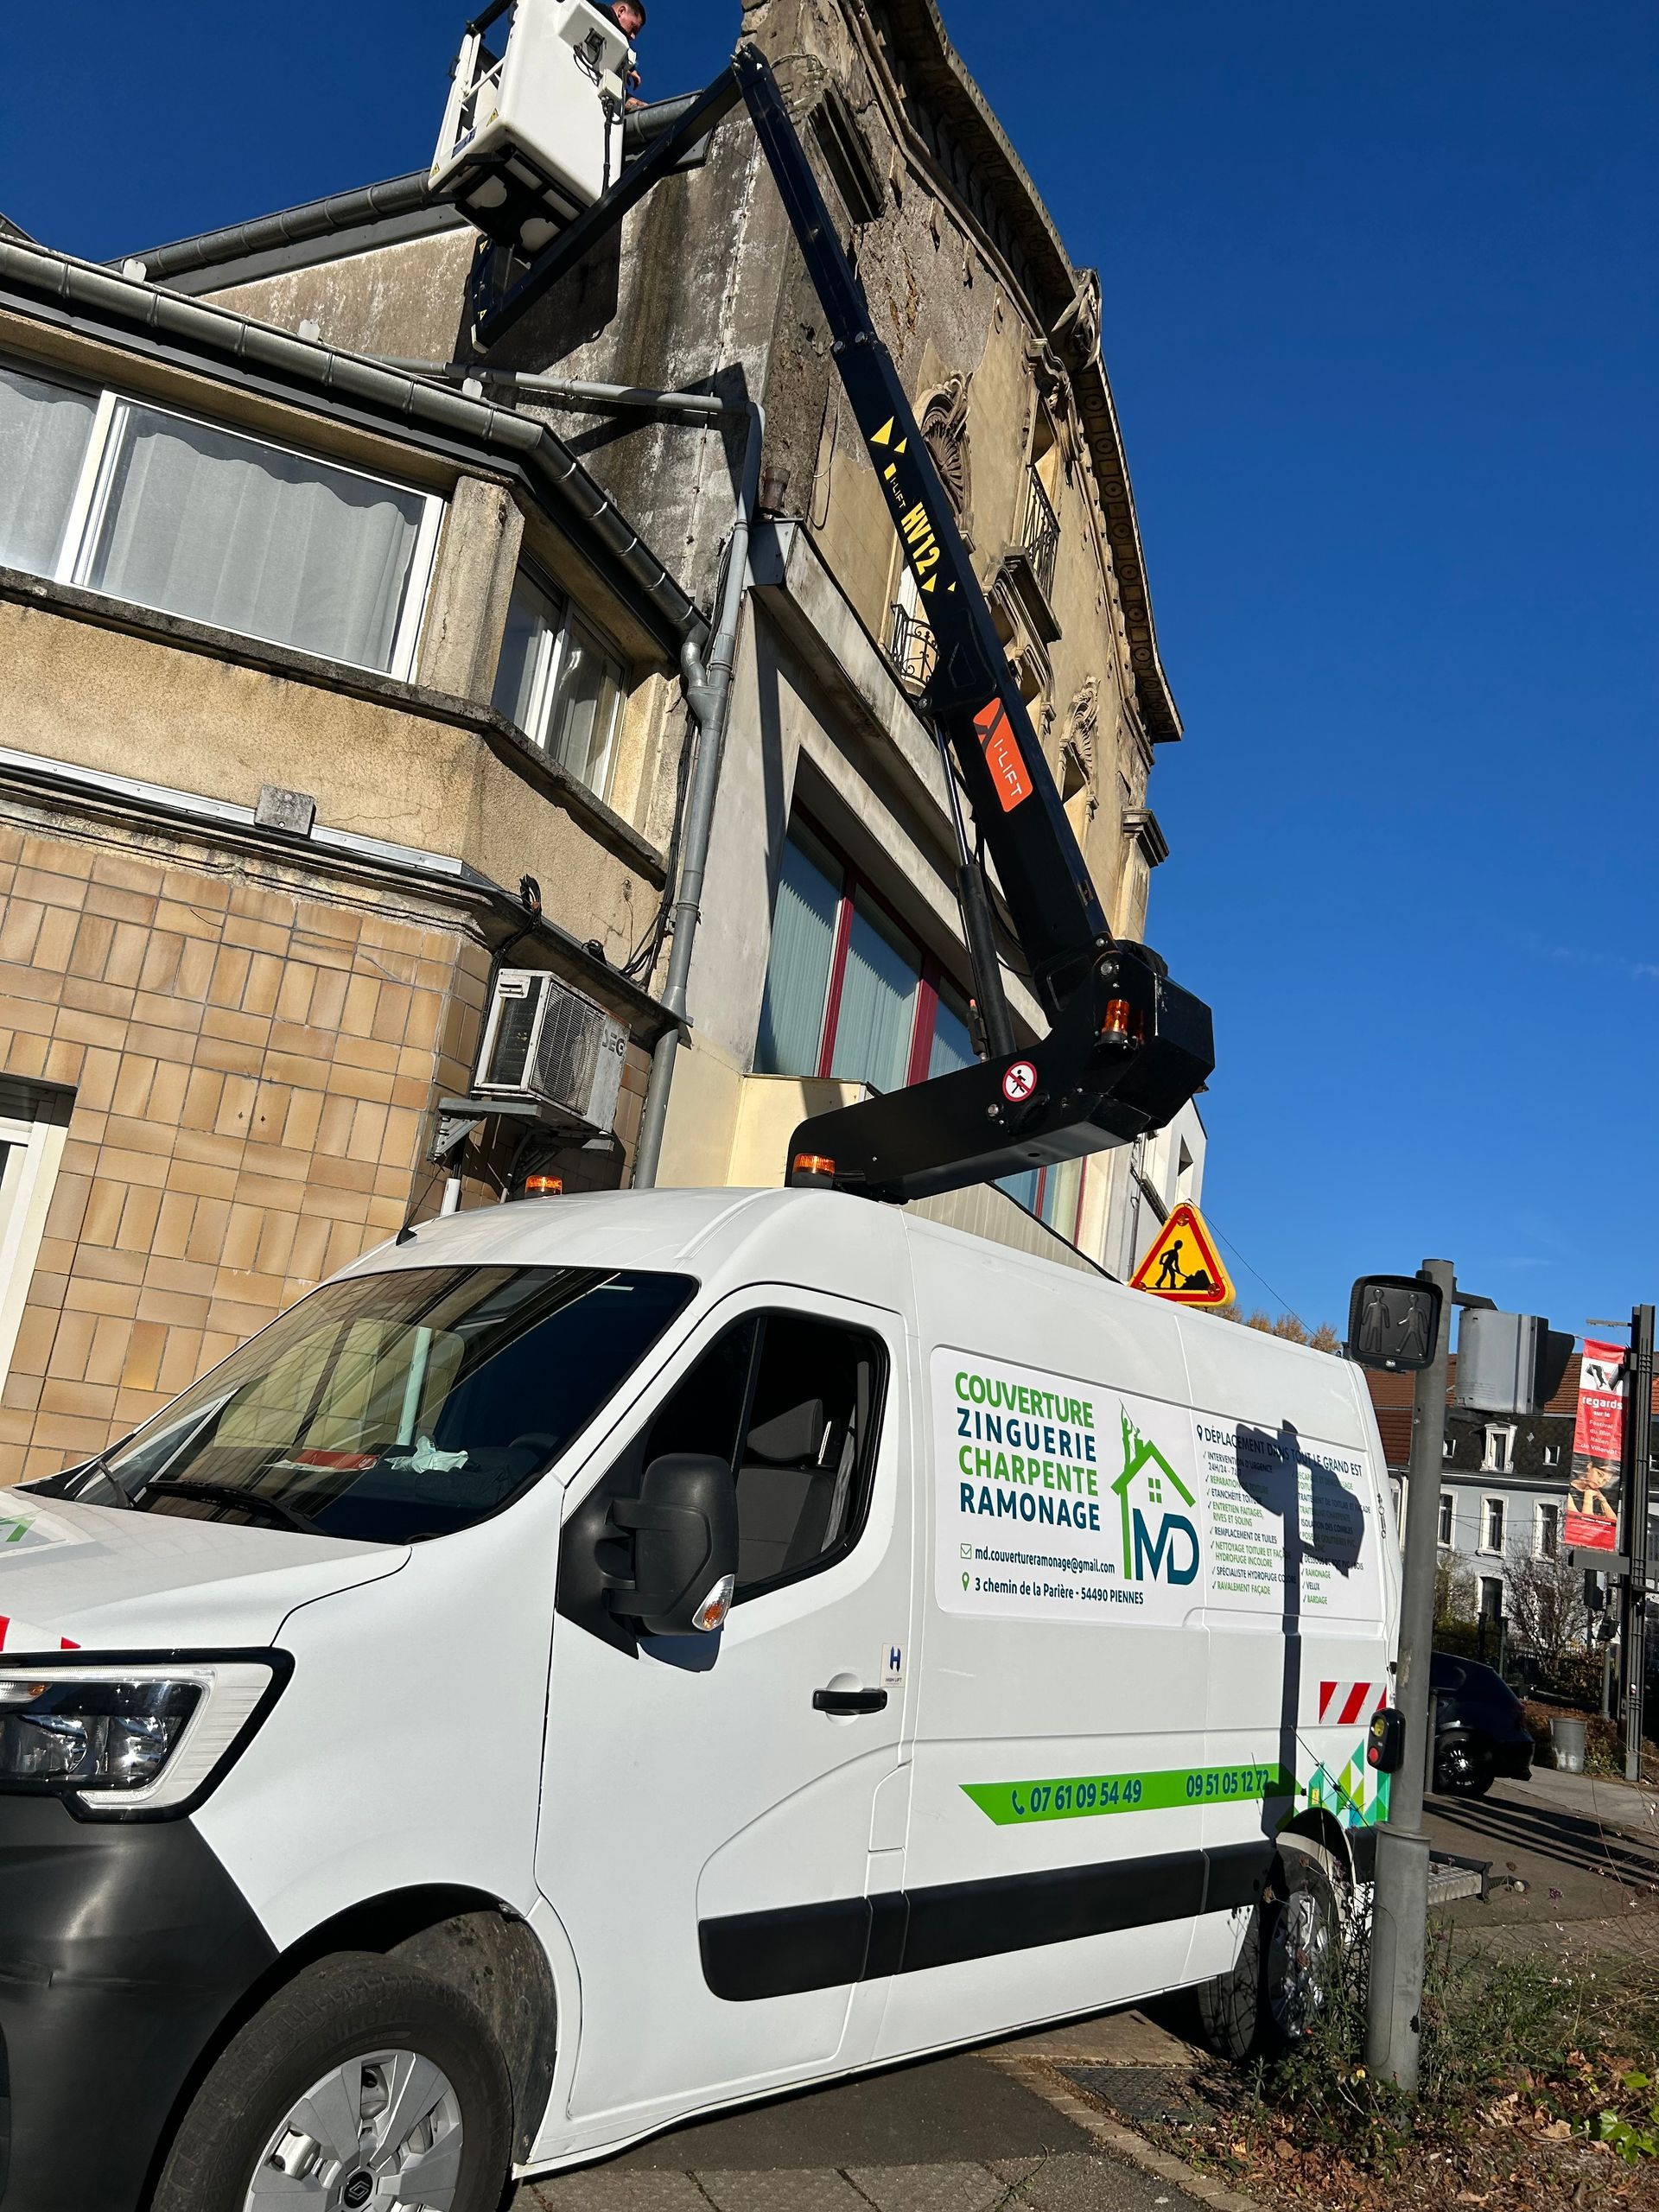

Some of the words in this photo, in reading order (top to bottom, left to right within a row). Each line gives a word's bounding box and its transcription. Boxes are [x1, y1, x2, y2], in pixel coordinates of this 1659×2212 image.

[900, 501, 940, 575] HV12
[955, 1371, 1095, 1428] COUVERTURE
[1582, 1396, 1623, 1410] regards
[1589, 1419, 1613, 1429] Festival
[957, 1407, 1096, 1462] ZINGUERIE
[1205, 1425, 1264, 1454] DÉPLACEMENT
[1267, 1442, 1290, 1460] DANS
[1291, 1449, 1312, 1466] TOUT
[1313, 1453, 1323, 1467] LE
[1323, 1457, 1350, 1473] GRAND
[1350, 1462, 1363, 1477] EST
[958, 1445, 1098, 1497] CHARPENTE
[960, 1482, 1101, 1531] RAMONAGE
[1212, 1501, 1239, 1514] ENTRETIEN
[1212, 1512, 1227, 1522] RIVES
[1227, 1515, 1234, 1523] ET
[1234, 1516, 1253, 1527] SOLINS
[1214, 1526, 1253, 1539] REMPLACEMENT
[1254, 1532, 1262, 1541] DE
[1262, 1534, 1278, 1544] TUILES
[1133, 1507, 1200, 1586] MD
[1215, 1541, 1245, 1554] NETTOYAGE
[1245, 1545, 1266, 1556] TOITURE
[1267, 1548, 1273, 1557] ET
[975, 1546, 1115, 1574] md.couvertureramonage@gmail.com
[1215, 1552, 1247, 1564] HYDROFUGE
[1248, 1556, 1273, 1567] INCOLORE
[1248, 1570, 1278, 1581] HYDROFUGE
[1306, 1568, 1331, 1579] RAMONAGE
[975, 1577, 981, 1591] 3
[983, 1578, 1018, 1595] chemin
[1020, 1580, 1031, 1595] de
[1033, 1582, 1041, 1596] la
[1043, 1584, 1074, 1599] Parière
[1081, 1588, 1109, 1601] 54490
[1109, 1589, 1144, 1605] PIENNES
[1217, 1581, 1250, 1592] RAVALEMENT
[1306, 1581, 1320, 1591] VELUX
[1307, 1595, 1328, 1605] BARDAGE
[1186, 1774, 1203, 1798] 09
[1205, 1773, 1219, 1796] 51
[1222, 1771, 1238, 1794] 05
[1241, 1770, 1253, 1793] 12
[1030, 1786, 1052, 1813] 07
[1054, 1783, 1071, 1810] 61
[1076, 1783, 1096, 1808] 09
[1099, 1780, 1119, 1806] 54
[1122, 1778, 1142, 1803] 49
